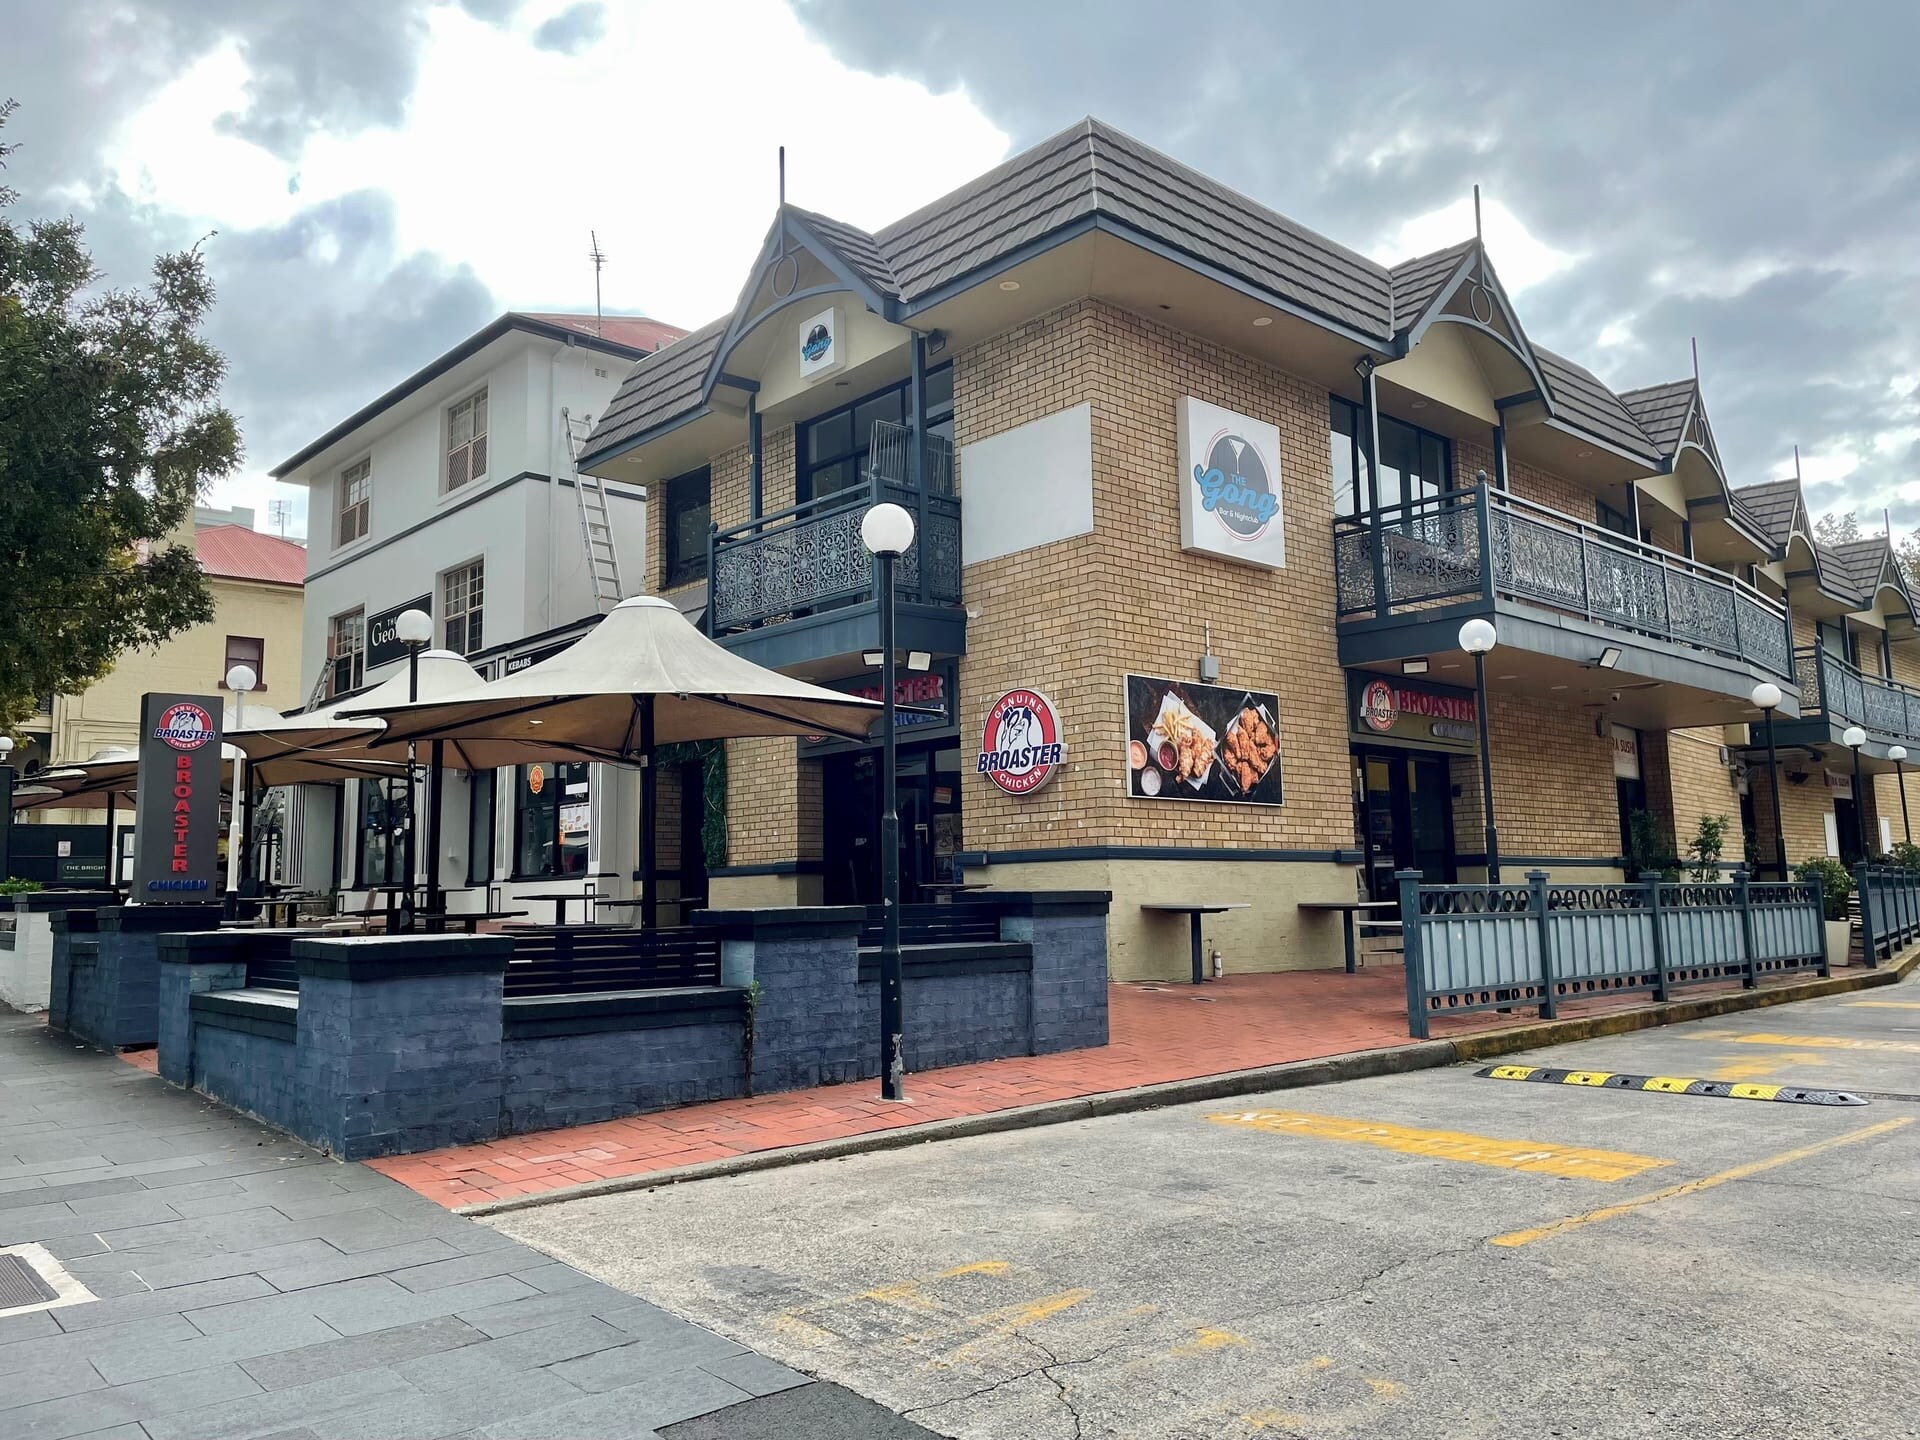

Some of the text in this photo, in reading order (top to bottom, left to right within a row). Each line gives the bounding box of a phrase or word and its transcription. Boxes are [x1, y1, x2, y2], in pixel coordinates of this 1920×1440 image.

[1229, 474, 1247, 486] THE
[1194, 464, 1279, 523] Gong
[1219, 506, 1229, 515] Bar
[508, 657, 531, 671] KEBABS
[170, 705, 204, 717] GENUINE
[995, 694, 1043, 719] GENUINE
[1399, 689, 1478, 721] BROASTER
[1365, 706, 1397, 719] BROASTER
[154, 728, 215, 740] BROASTER
[170, 739, 201, 748] CHICKEN
[977, 743, 1062, 772] BROASTER
[999, 768, 1042, 788] CHICKEN
[172, 755, 192, 872] BROASTER
